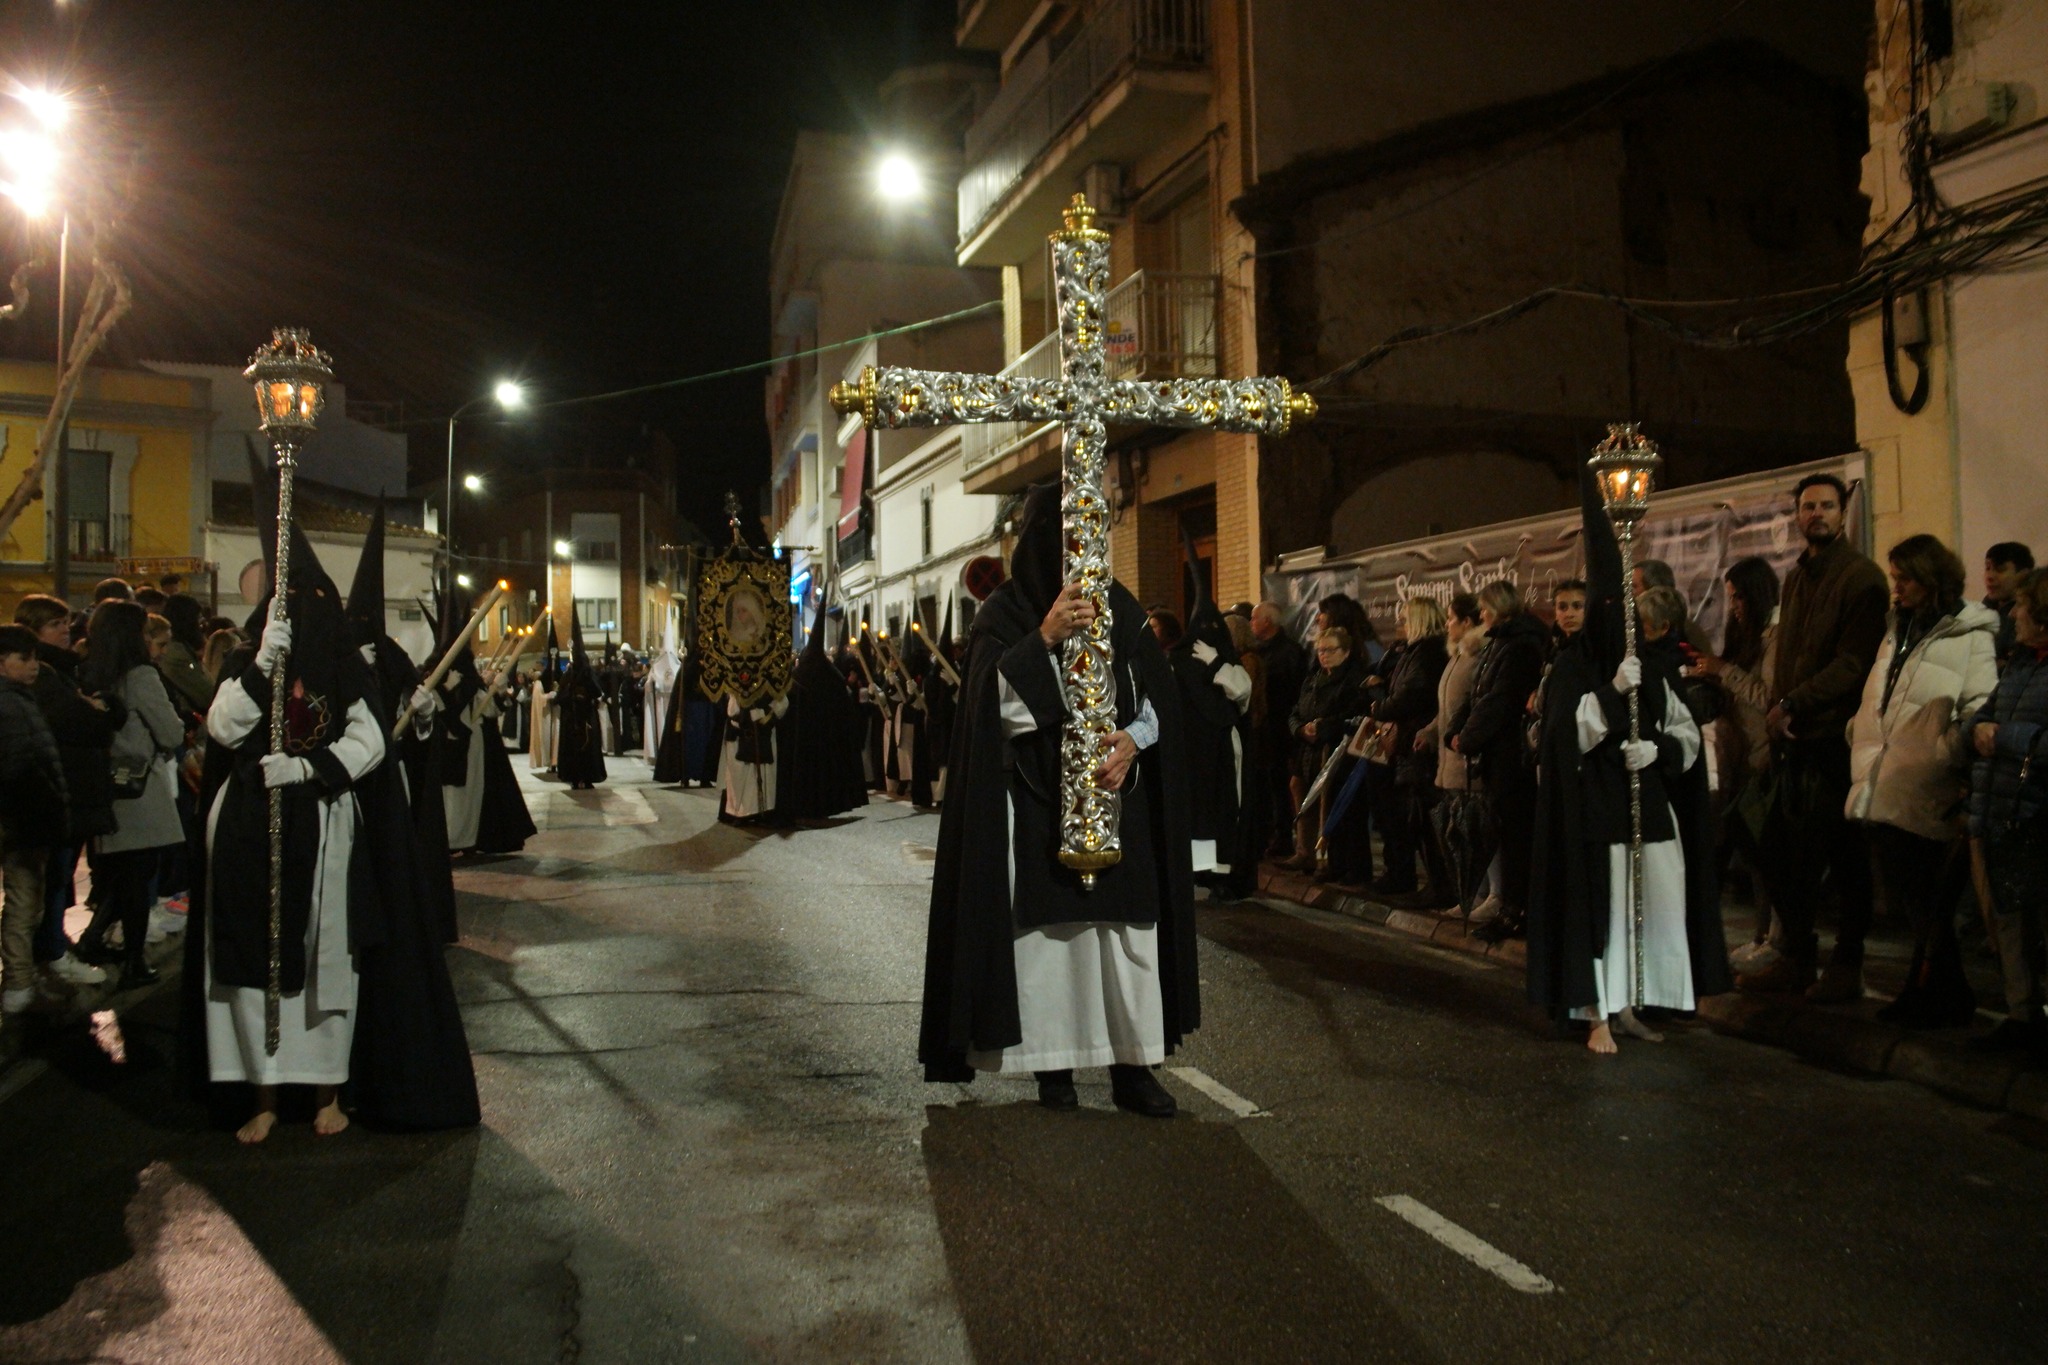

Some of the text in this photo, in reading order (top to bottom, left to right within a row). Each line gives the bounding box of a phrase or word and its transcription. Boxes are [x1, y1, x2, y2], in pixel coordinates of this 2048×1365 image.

[1107, 333, 1136, 344] NDE
[1395, 573, 1454, 612] Semana
[1460, 556, 1519, 594] Santa
